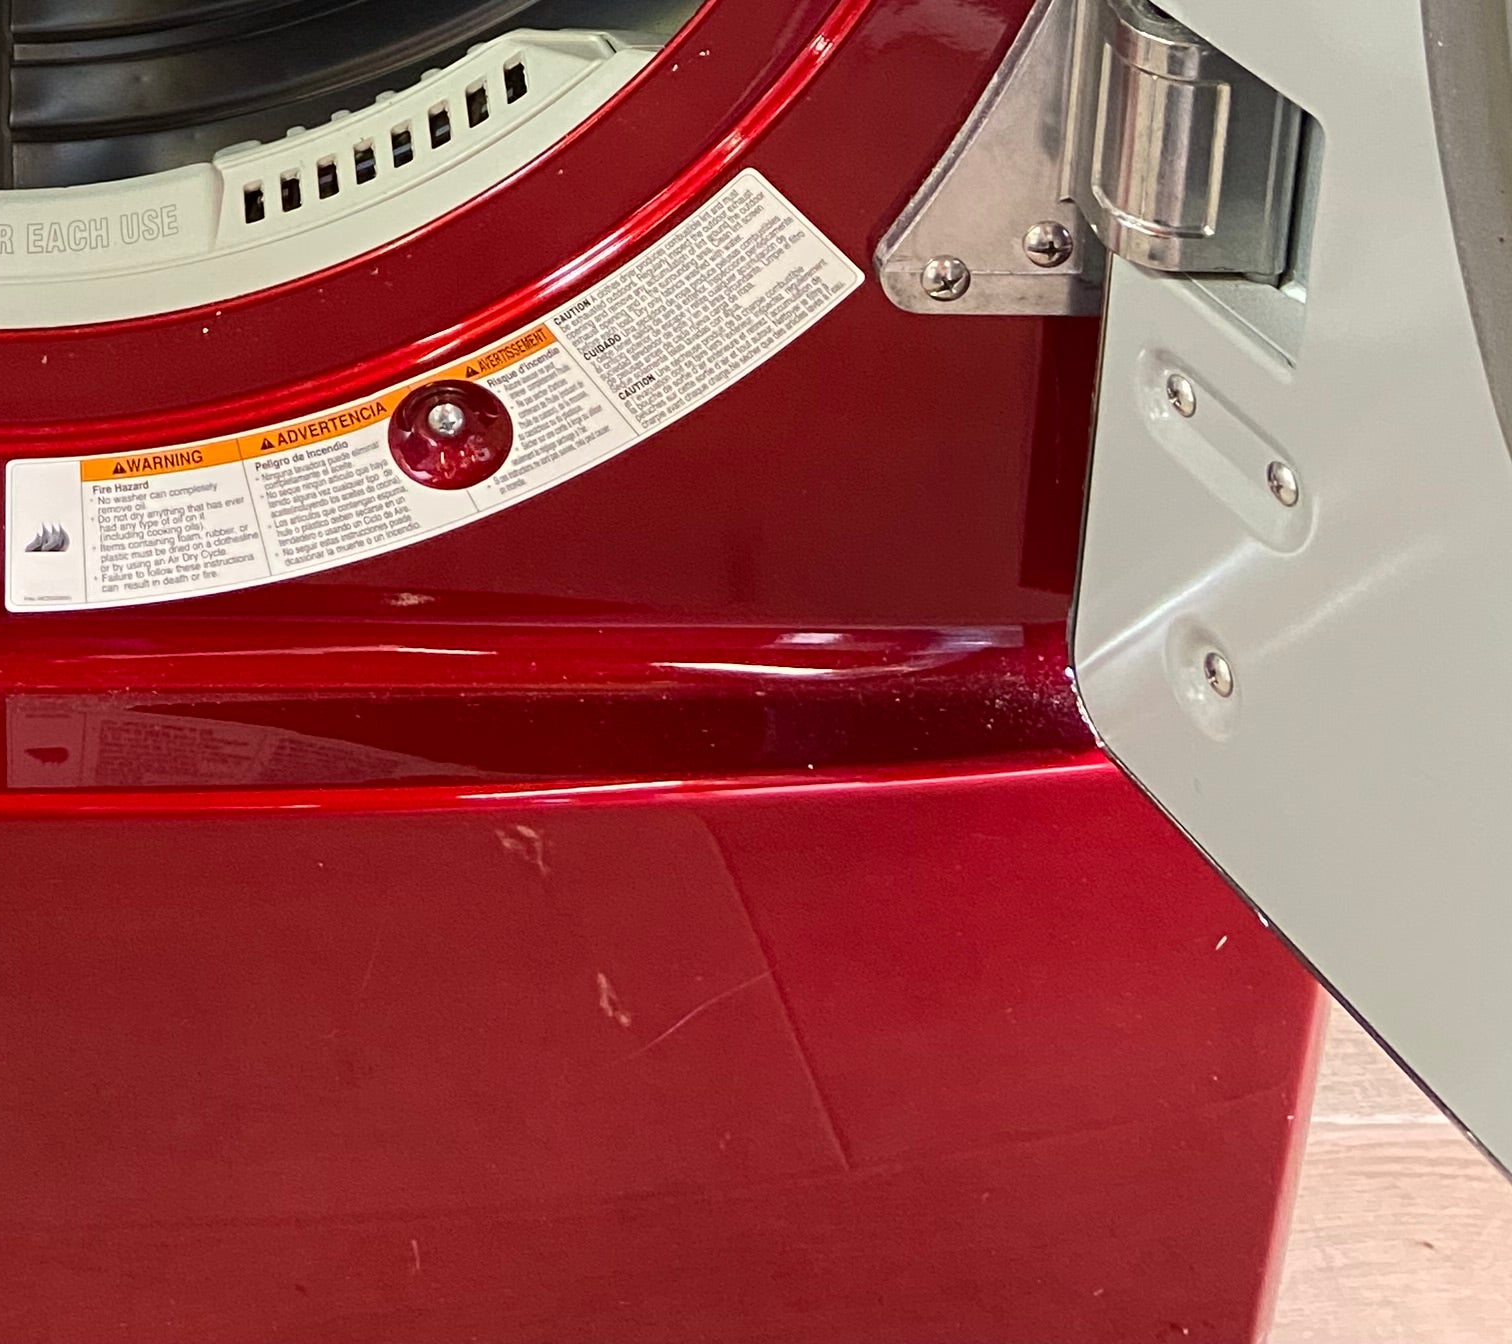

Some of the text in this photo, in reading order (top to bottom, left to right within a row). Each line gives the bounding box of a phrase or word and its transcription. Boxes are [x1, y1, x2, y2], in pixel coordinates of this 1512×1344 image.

[26, 217, 109, 254] EACH
[119, 204, 179, 245] USE
[552, 296, 591, 326] CAUTION
[477, 327, 547, 375] AVERTISSEMENT
[583, 333, 622, 362] CUIDADO
[487, 345, 561, 389] Risque d'incendie
[618, 373, 656, 402] CAUTION
[277, 401, 387, 447] ADVERTENCIA
[126, 450, 203, 472] WARNING
[256, 439, 349, 471] Peligro de Incendio
[92, 480, 149, 495] Fire Hazard
[98, 497, 111, 505] No
[114, 493, 147, 503] washer
[150, 491, 166, 499] can
[98, 514, 111, 524] Do
[114, 512, 128, 522] not
[130, 510, 144, 522] dry
[206, 500, 223, 509] has
[100, 522, 117, 532] had
[120, 521, 136, 531] any
[161, 516, 171, 525] of
[102, 572, 132, 582] Failure
[136, 569, 144, 578] to
[102, 583, 119, 592] can
